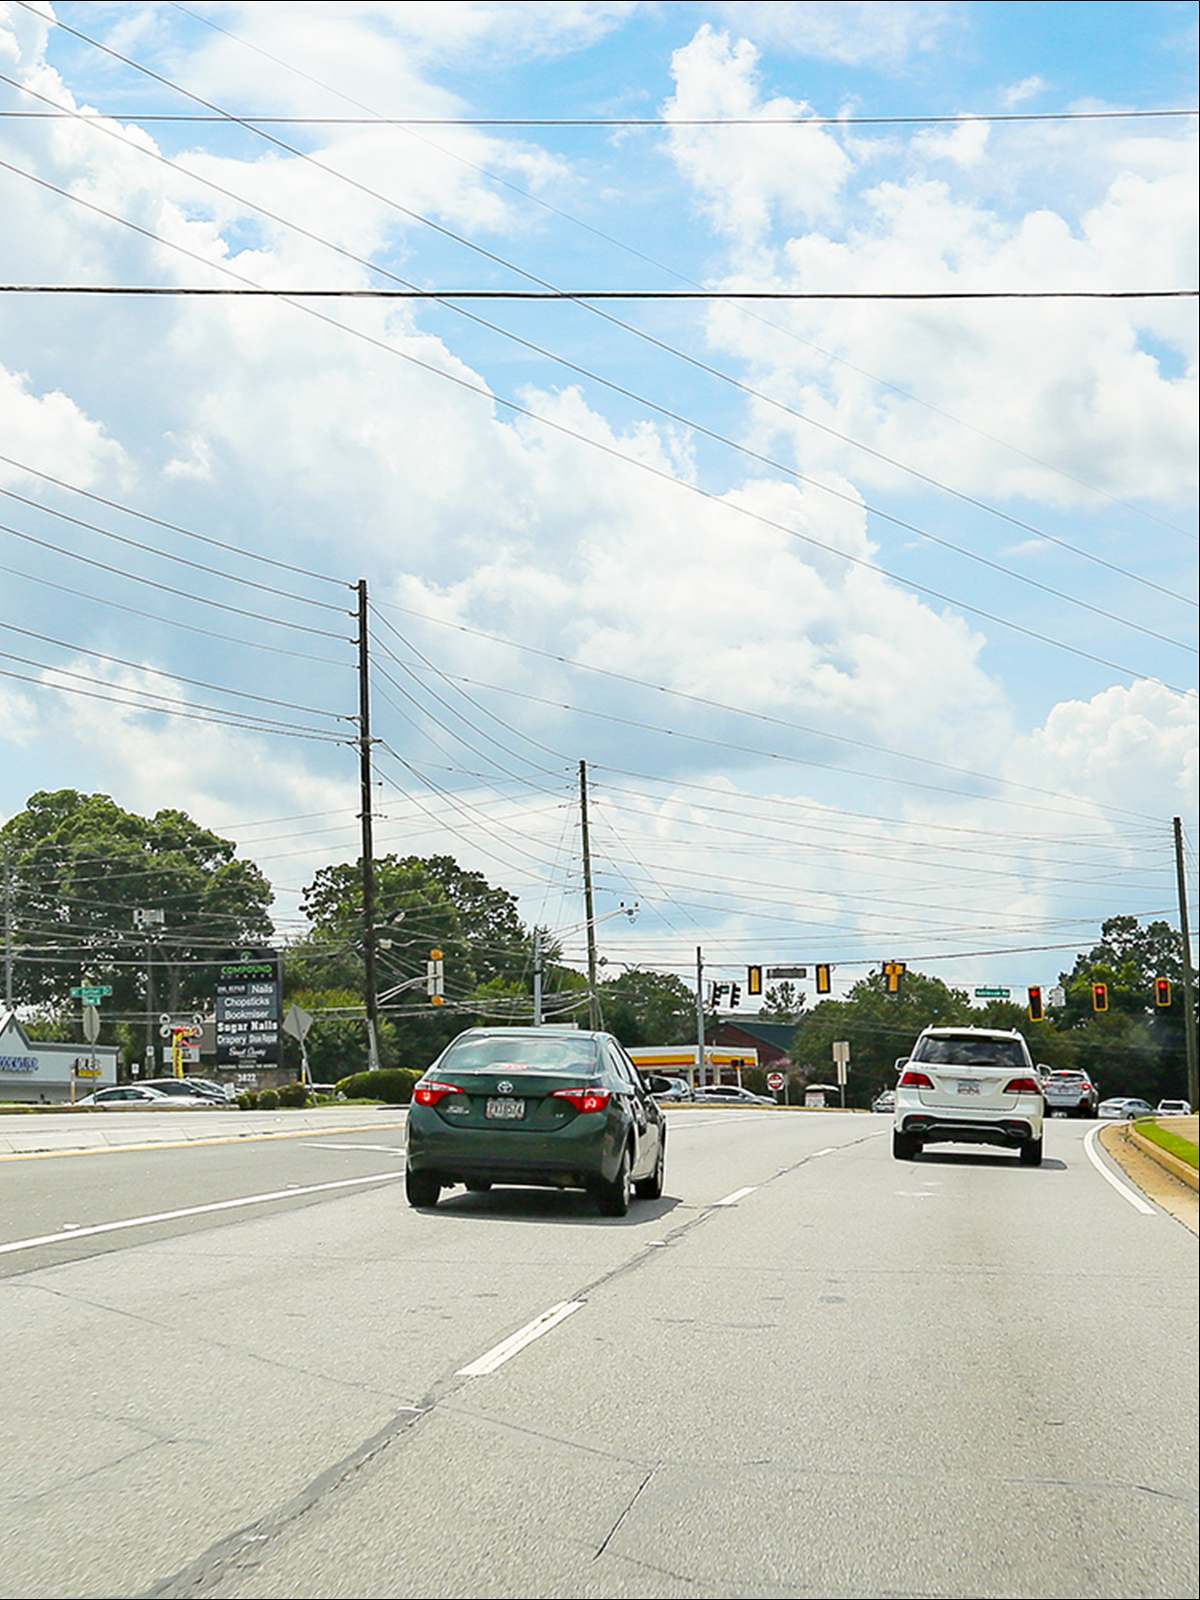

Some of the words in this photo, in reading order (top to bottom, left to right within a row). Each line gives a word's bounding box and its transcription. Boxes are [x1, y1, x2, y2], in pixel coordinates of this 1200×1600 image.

[221, 964, 273, 974] COMPOUND
[252, 984, 274, 994] Nails
[224, 997, 270, 1008] Chopsticks
[224, 1010, 270, 1020] Bookmiser
[217, 1022, 248, 1034] Sugar
[251, 1020, 278, 1031] Nails
[216, 1034, 247, 1045] Drapery
[236, 1073, 257, 1082] 3822
